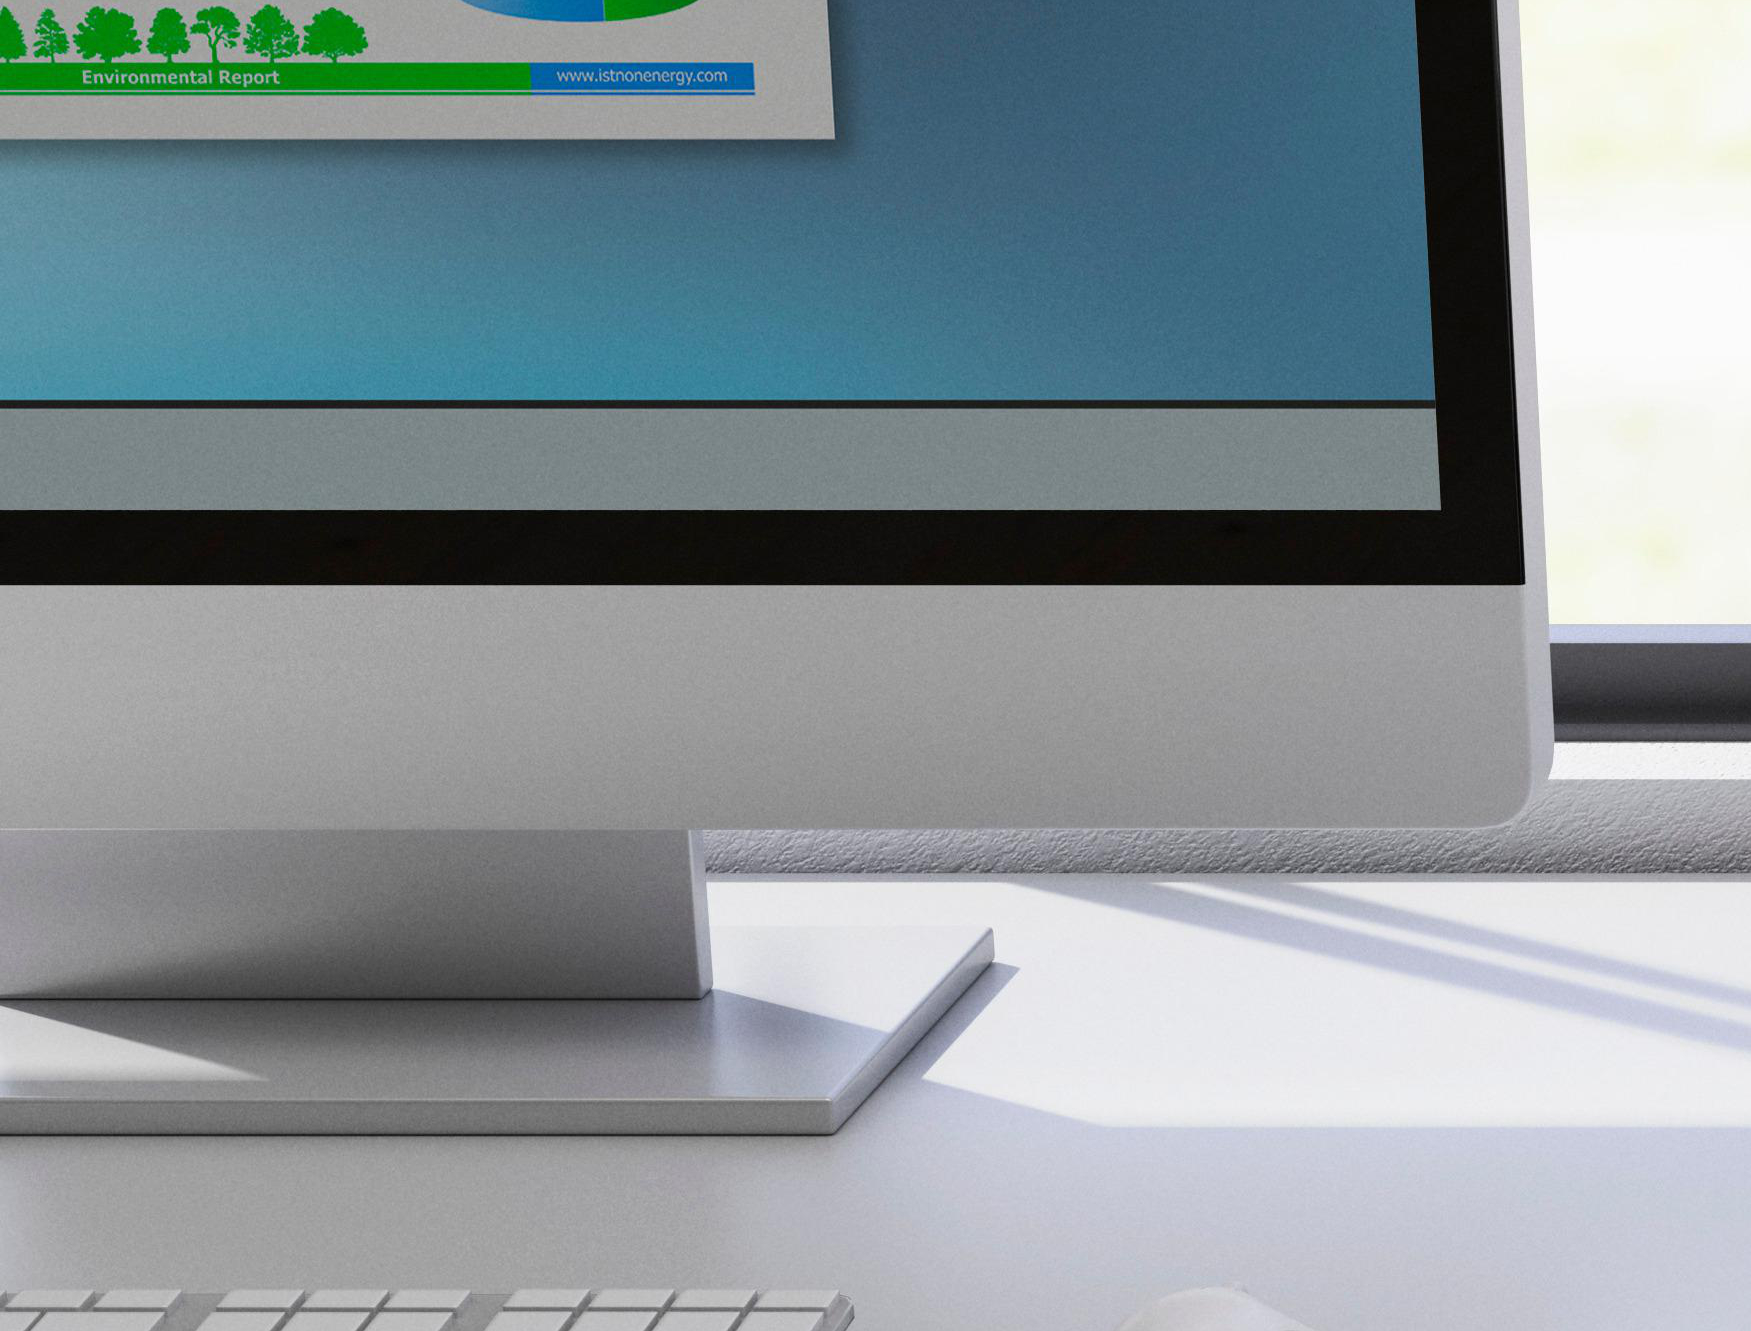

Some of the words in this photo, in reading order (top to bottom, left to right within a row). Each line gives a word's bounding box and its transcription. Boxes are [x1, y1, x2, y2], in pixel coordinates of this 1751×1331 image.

[82, 70, 212, 84] Environmental
[219, 70, 281, 87] Report
[556, 68, 727, 85] www.istnonenergy.com
